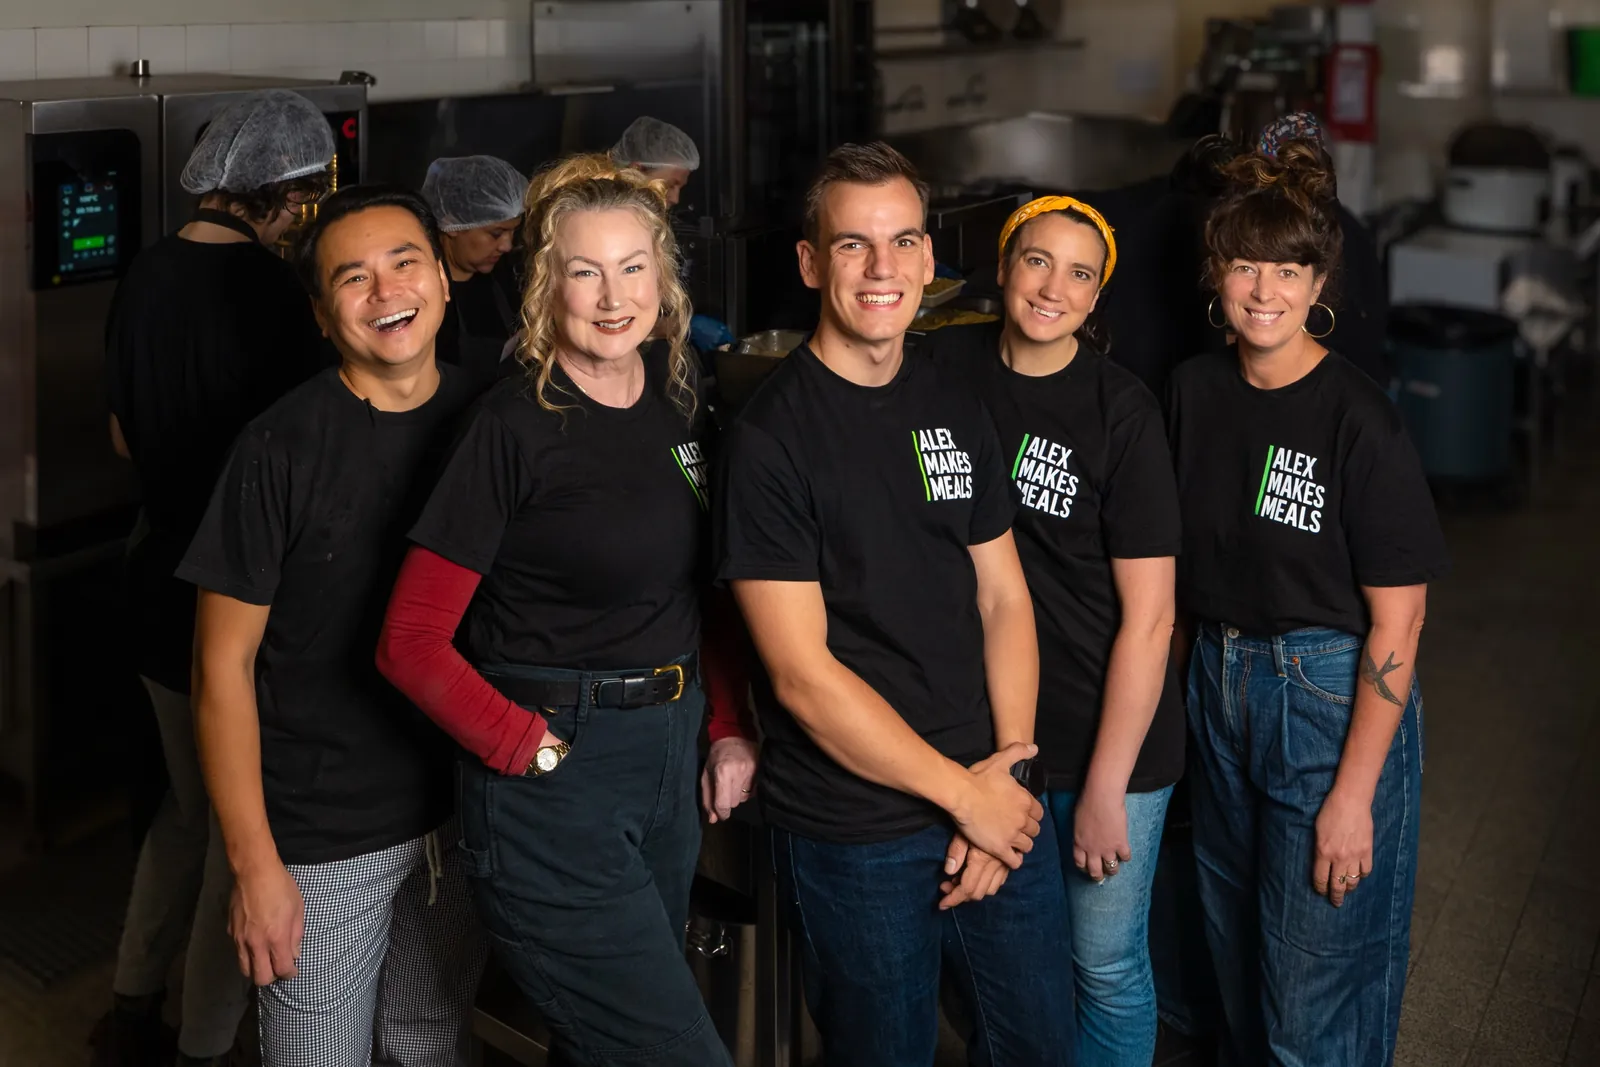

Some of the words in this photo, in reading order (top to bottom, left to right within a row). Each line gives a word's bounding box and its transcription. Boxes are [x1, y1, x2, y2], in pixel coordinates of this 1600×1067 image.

[919, 428, 957, 451] ALEX
[1025, 436, 1073, 470] ALEX
[922, 450, 972, 476] MAKES
[1018, 457, 1079, 497] MAKES
[1272, 447, 1318, 480] ALEX
[929, 475, 973, 501] MEALS
[1016, 480, 1073, 519] MEALS
[1266, 470, 1326, 508] MAKES
[1260, 494, 1322, 533] MEALS
